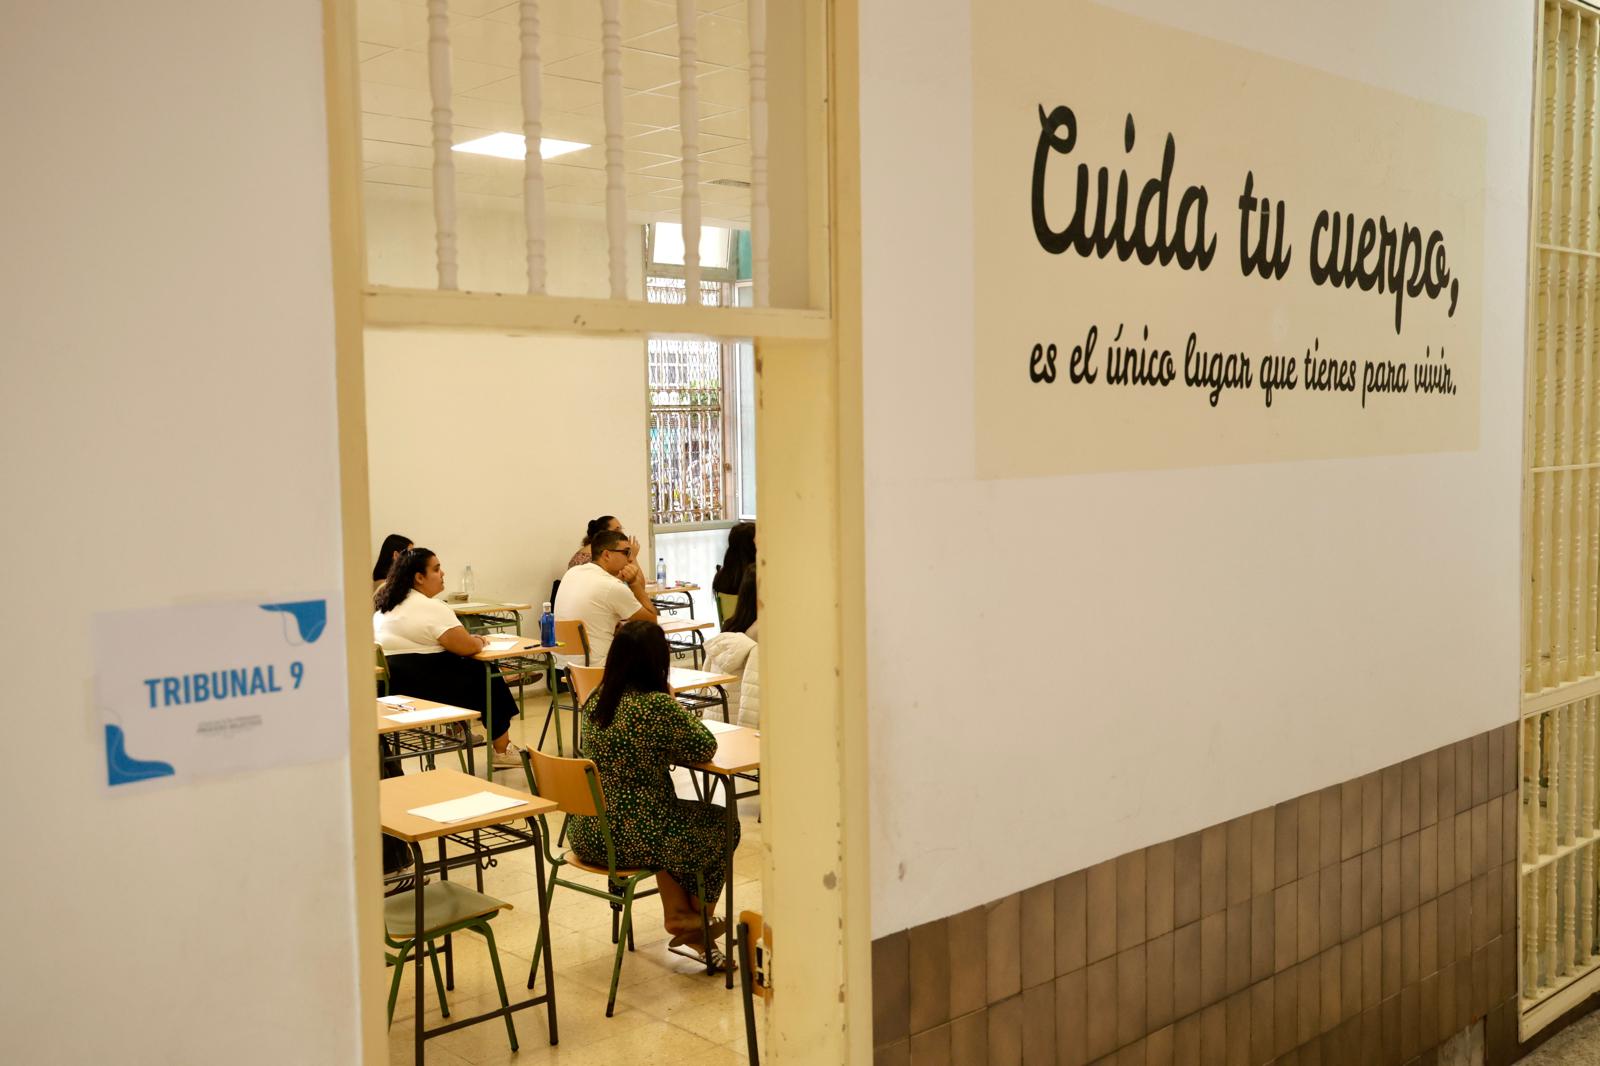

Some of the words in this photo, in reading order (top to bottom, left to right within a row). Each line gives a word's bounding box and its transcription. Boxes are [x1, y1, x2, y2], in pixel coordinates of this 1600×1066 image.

[1031, 103, 1218, 272] Cuida
[1238, 170, 1292, 281] tu
[1309, 209, 1459, 335] cuerpo,
[1029, 343, 1058, 384] es
[1069, 325, 1098, 385] el
[1106, 323, 1177, 387] único
[1184, 331, 1254, 408] lugar
[1259, 354, 1298, 408] que
[1303, 337, 1357, 392] tienes
[1361, 360, 1409, 409] para
[1414, 345, 1457, 396] vivir.
[143, 664, 282, 708] TRIBUNAL
[290, 661, 304, 690] 9
